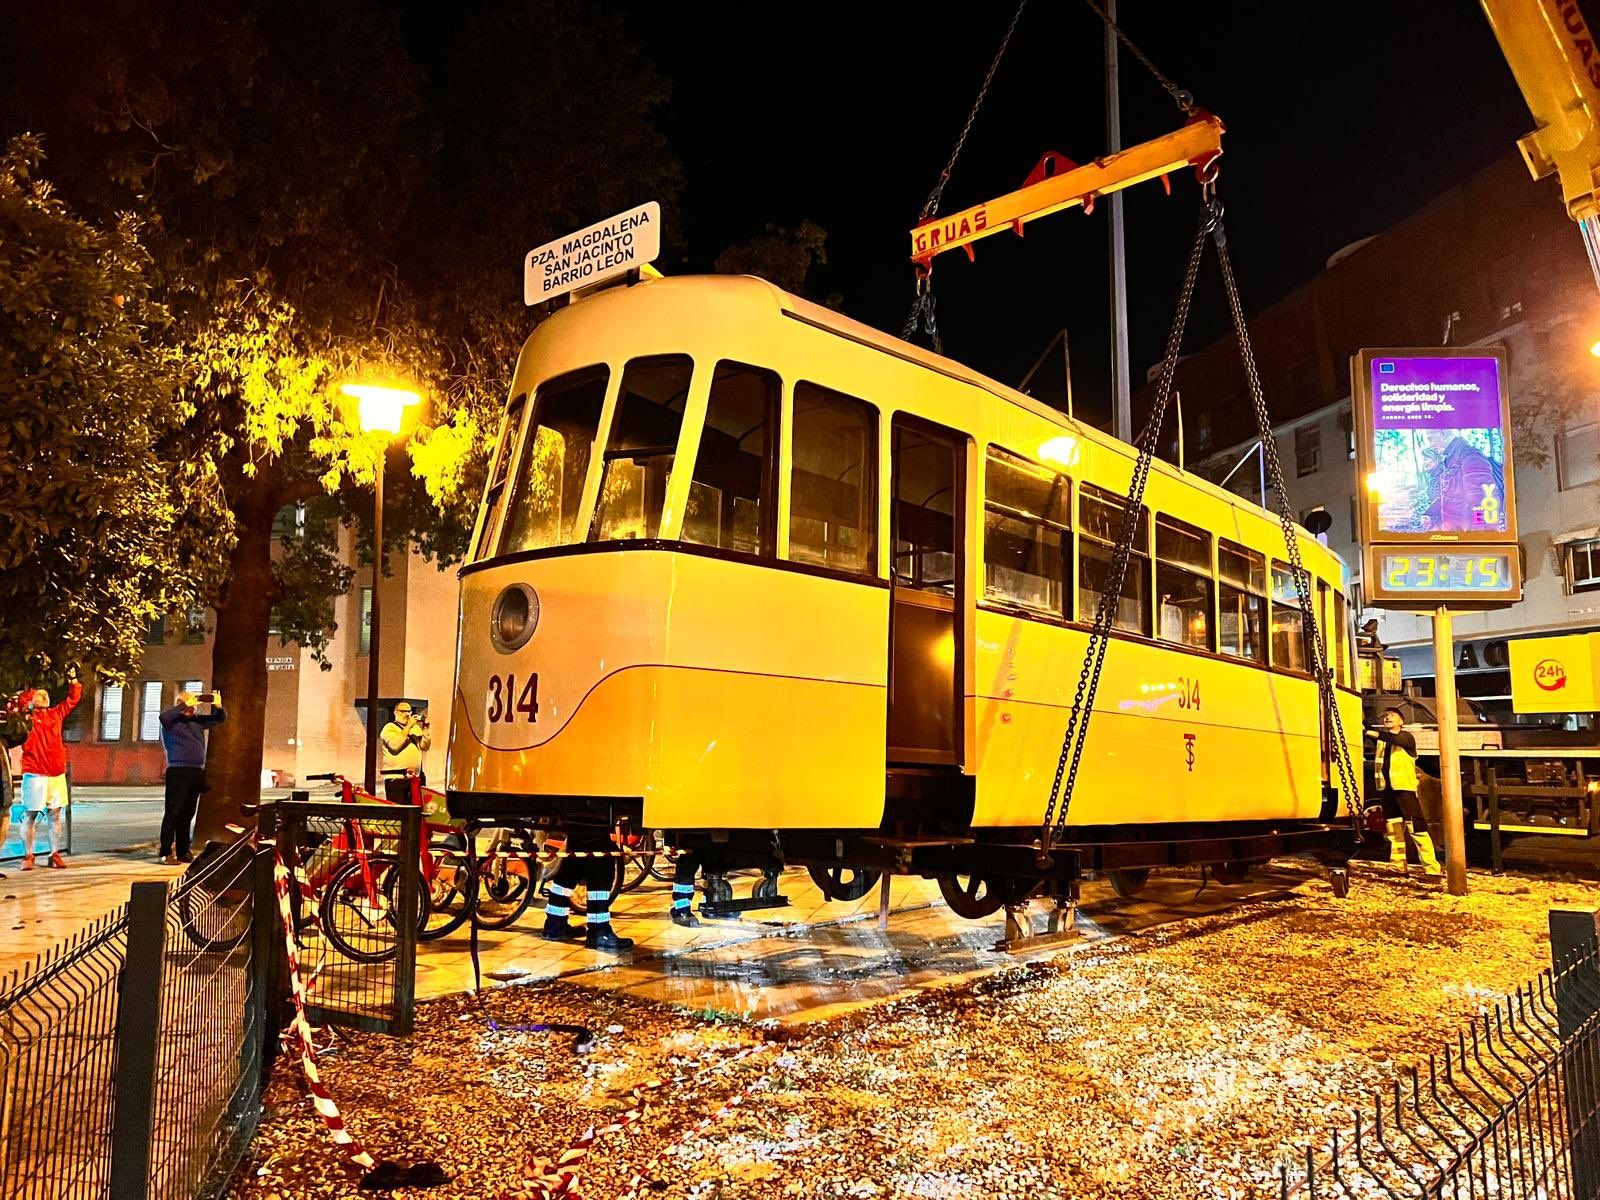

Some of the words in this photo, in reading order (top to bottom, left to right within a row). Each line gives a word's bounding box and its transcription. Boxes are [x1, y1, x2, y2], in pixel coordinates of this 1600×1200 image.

[531, 249, 559, 269] PZA.
[562, 211, 650, 256] MAGDALENA
[915, 210, 987, 252] GRUAS
[543, 263, 593, 292] BARRIO
[597, 246, 635, 272] LEÓN
[544, 256, 571, 277] SAN
[574, 233, 634, 265] JACINTO
[1380, 382, 1430, 392] Derechos
[1430, 382, 1480, 392] humanos,
[1381, 392, 1438, 402] solidaridad
[1438, 394, 1445, 403] y
[1389, 558, 1498, 587] 23:15
[1538, 666, 1565, 679] 24h
[488, 672, 539, 723] 314
[1178, 676, 1201, 711] 314
